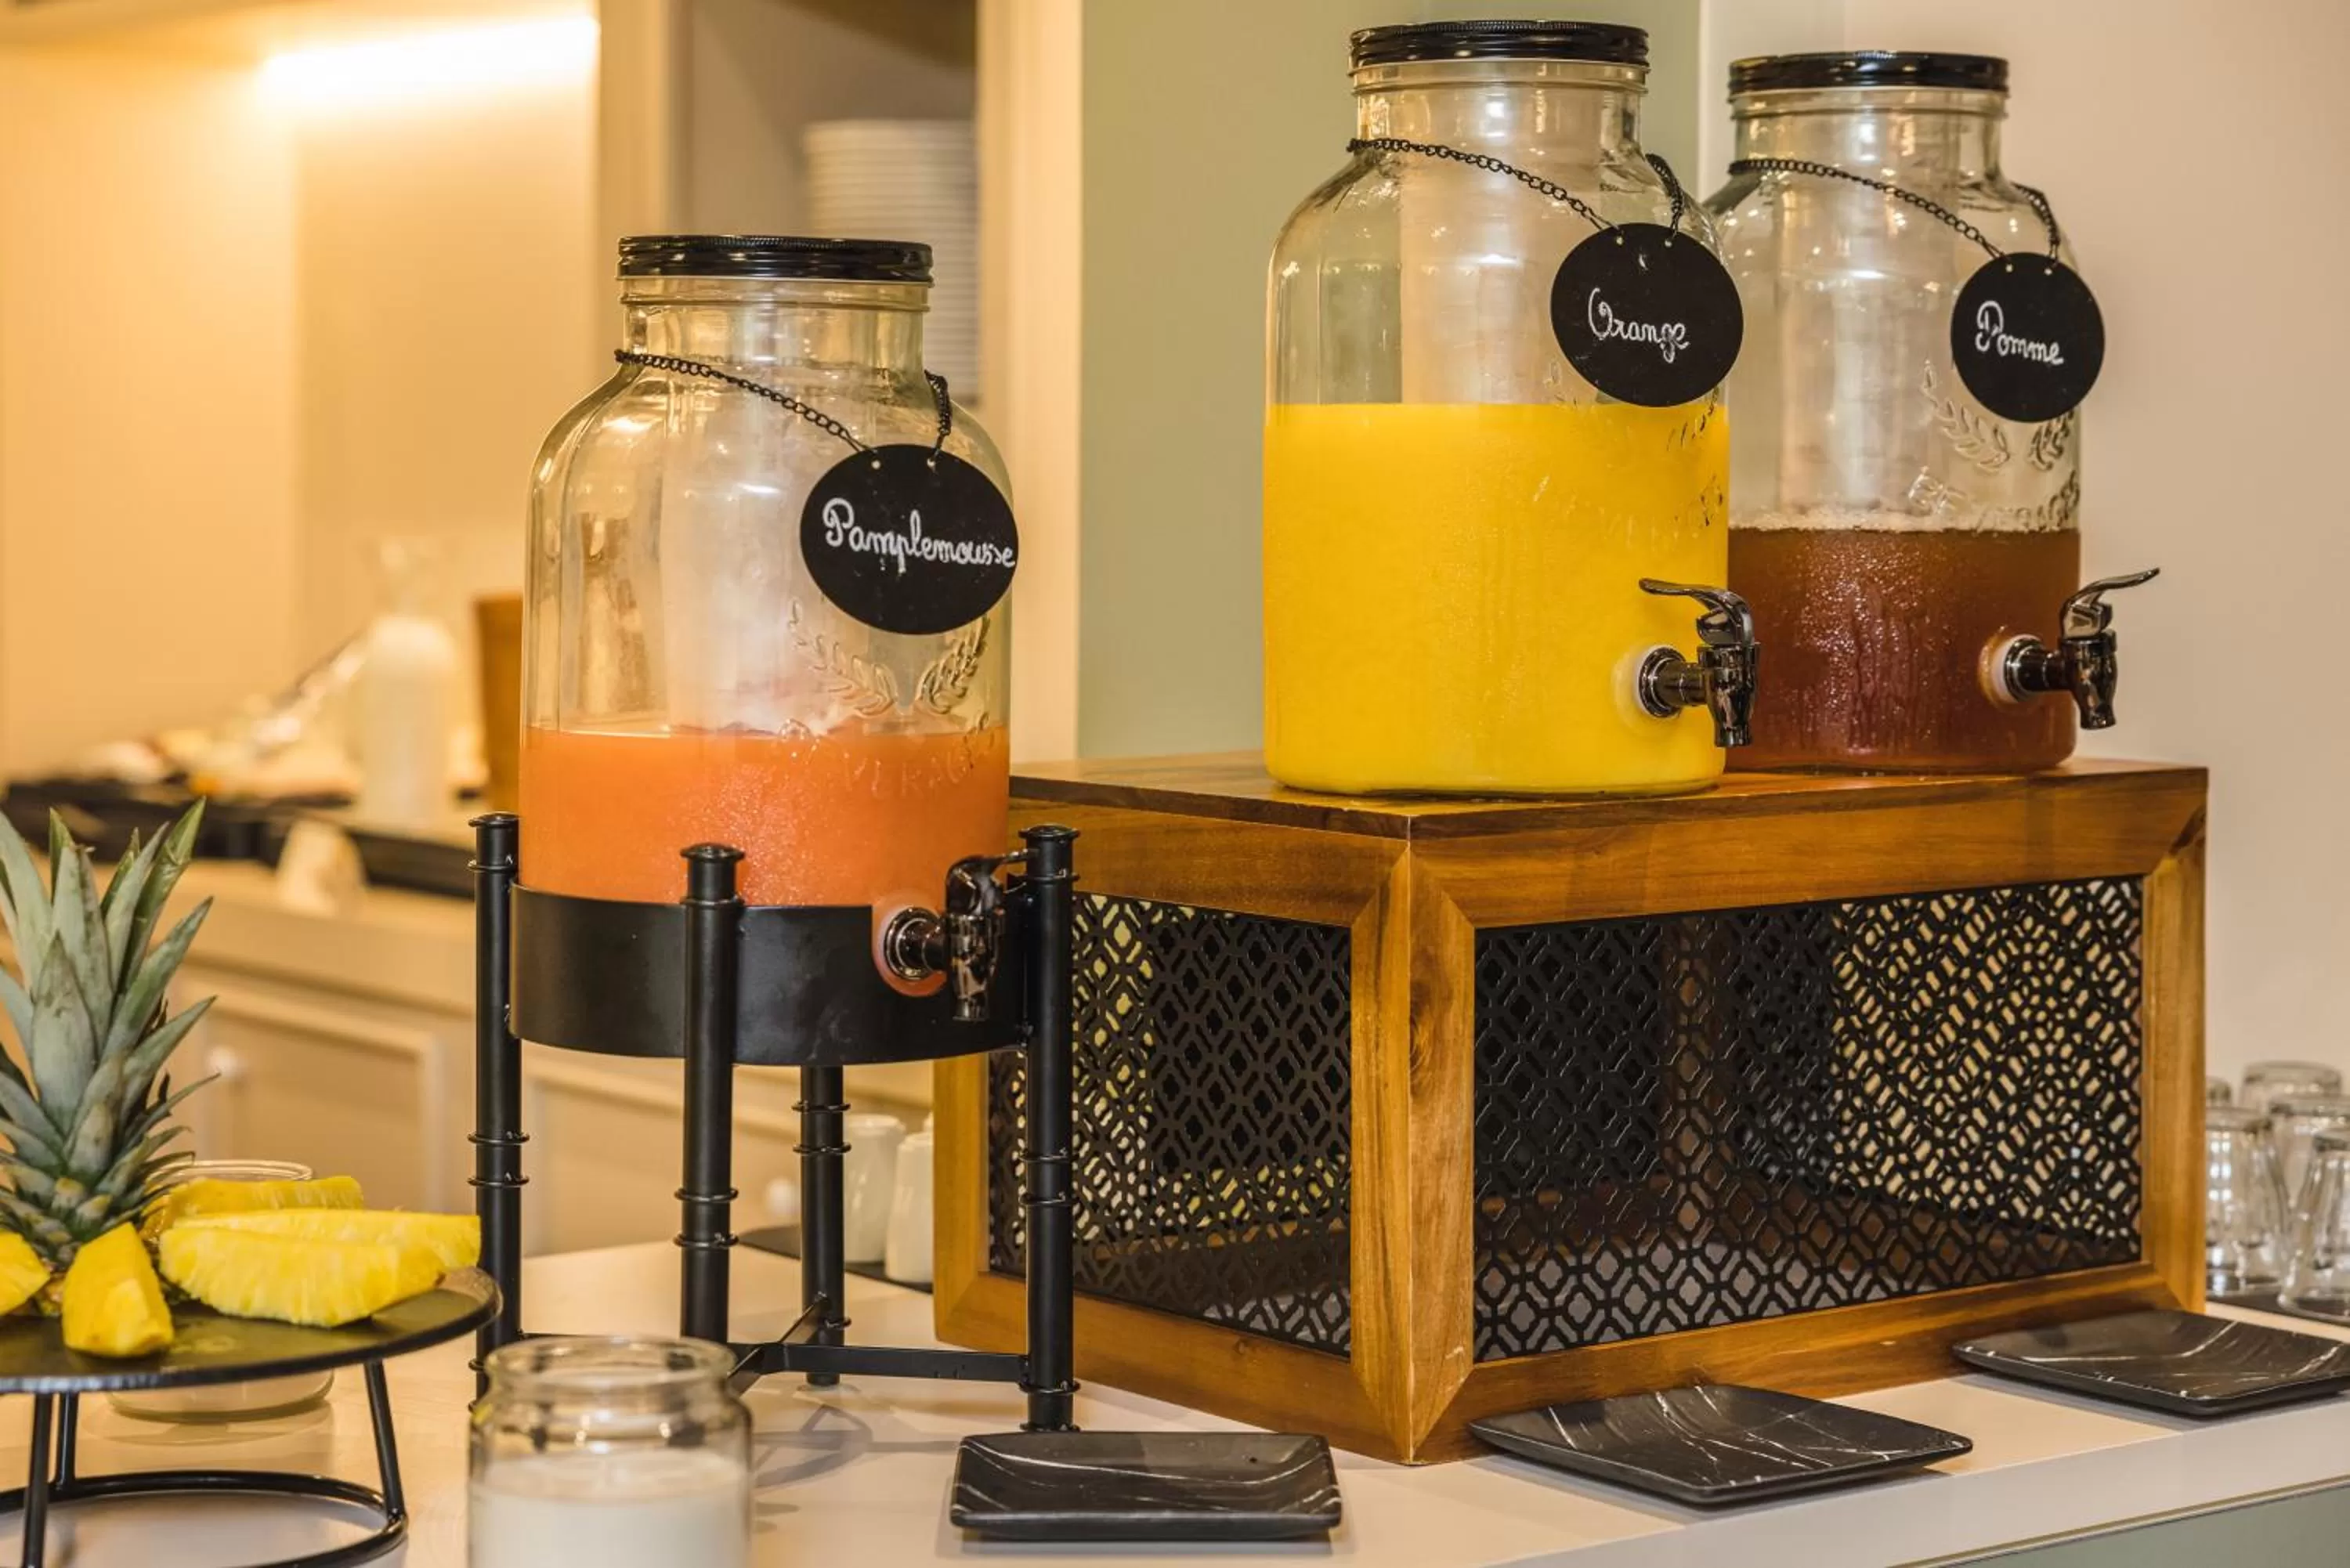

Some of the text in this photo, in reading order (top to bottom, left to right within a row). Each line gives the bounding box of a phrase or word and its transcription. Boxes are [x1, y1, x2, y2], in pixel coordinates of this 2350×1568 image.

[1588, 287, 1690, 363] Orange
[1975, 300, 2065, 366] Pomme
[822, 497, 1016, 574] Pamplemousse
